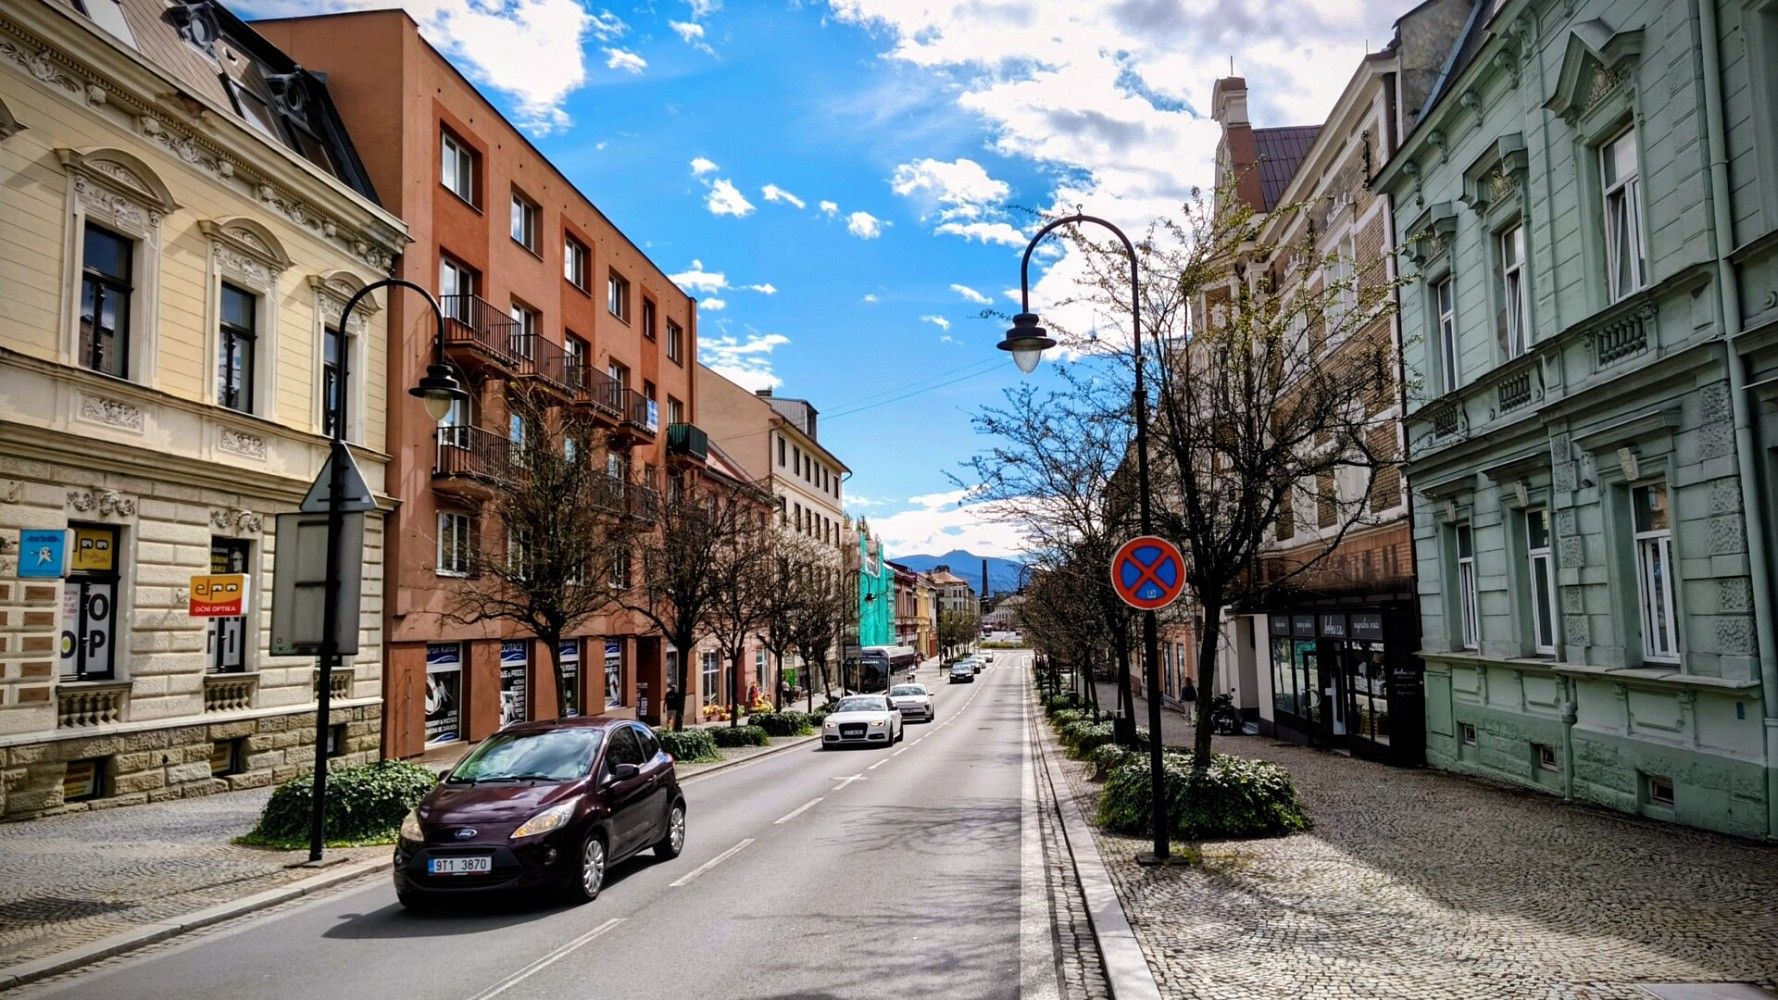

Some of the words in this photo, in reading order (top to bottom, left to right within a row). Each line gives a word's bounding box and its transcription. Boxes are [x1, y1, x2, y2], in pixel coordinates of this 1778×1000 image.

[195, 579, 239, 600] elpo
[436, 860, 454, 871] 9T1
[461, 859, 487, 870] 3870
